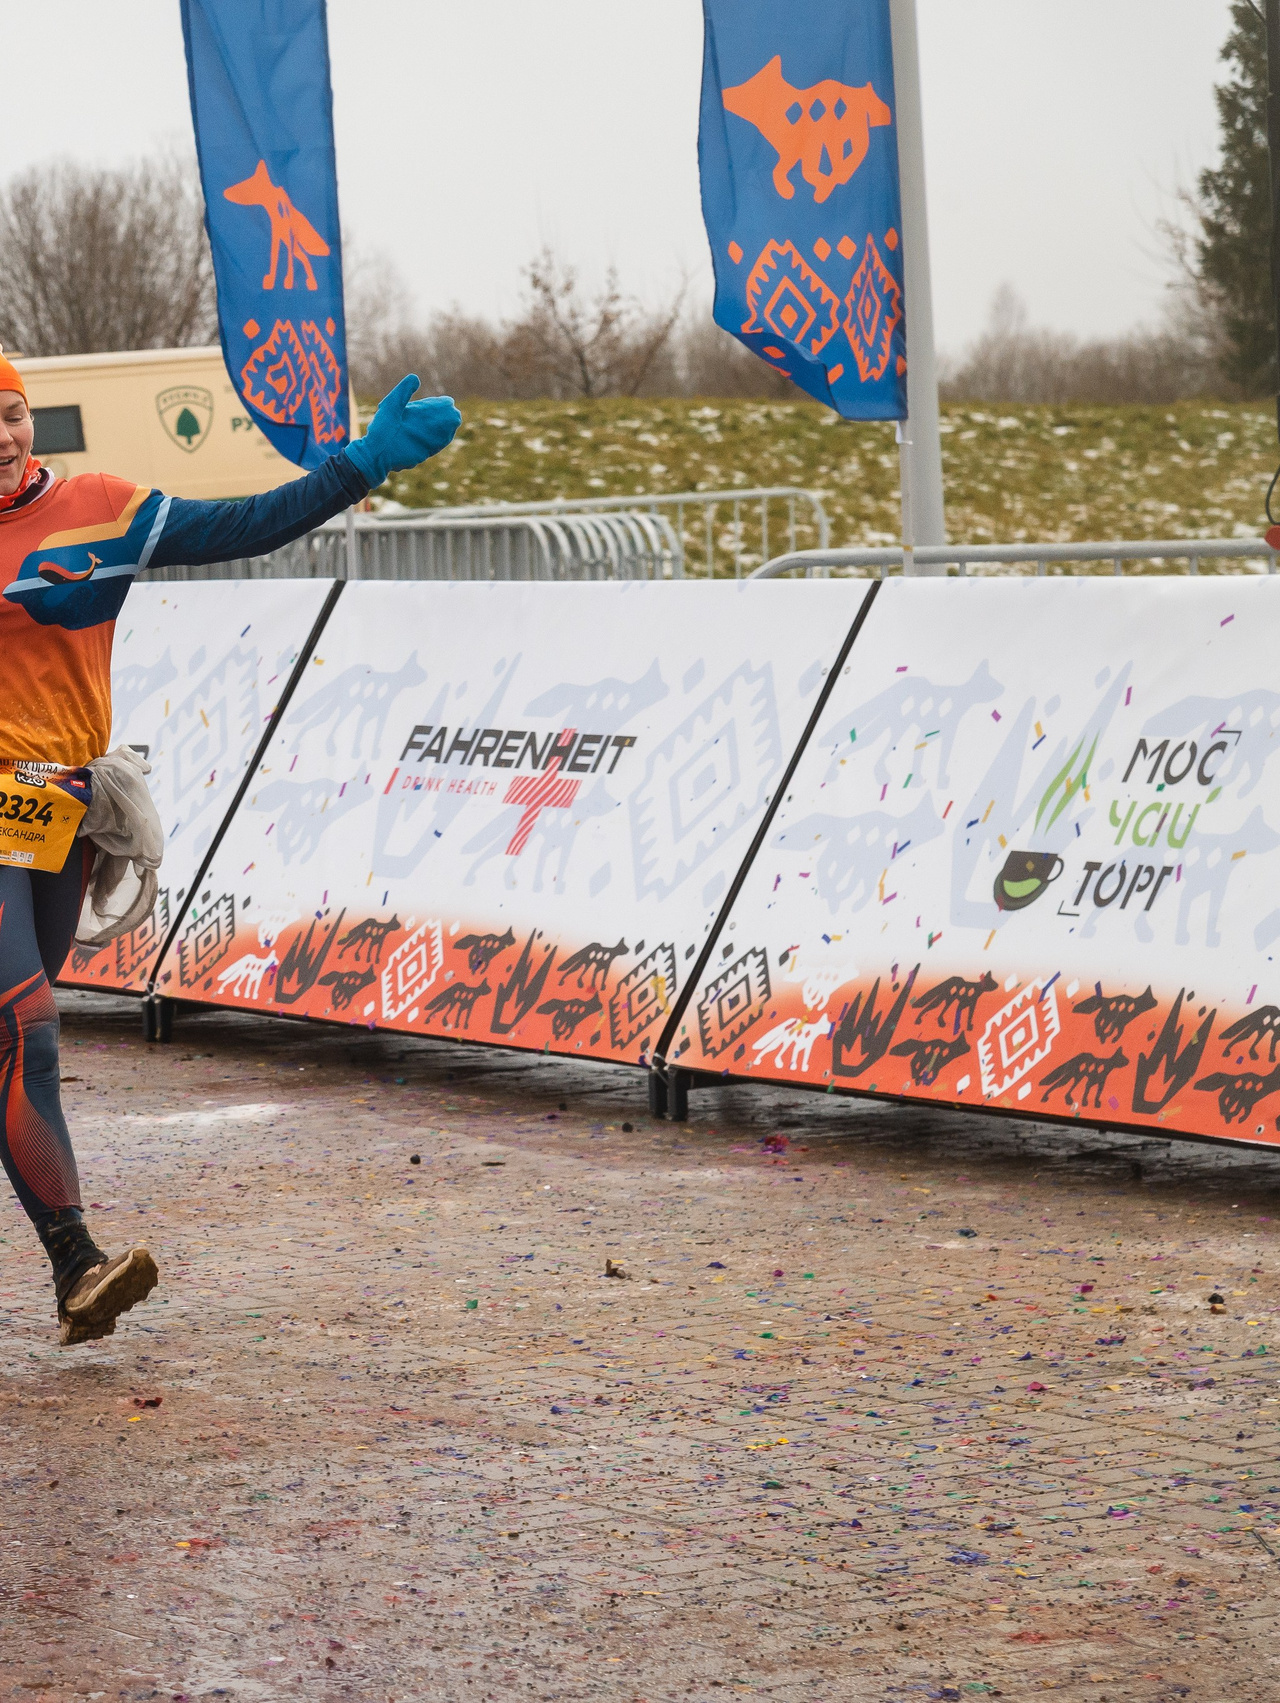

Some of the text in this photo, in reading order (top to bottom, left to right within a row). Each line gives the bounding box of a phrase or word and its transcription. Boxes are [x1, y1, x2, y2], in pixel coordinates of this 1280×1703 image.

[399, 725, 638, 774] FAHRENHEIT
[1121, 738, 1228, 786] МОС
[402, 775, 498, 796] DRINK HEALTH
[1073, 861, 1174, 911] ТОРГ
